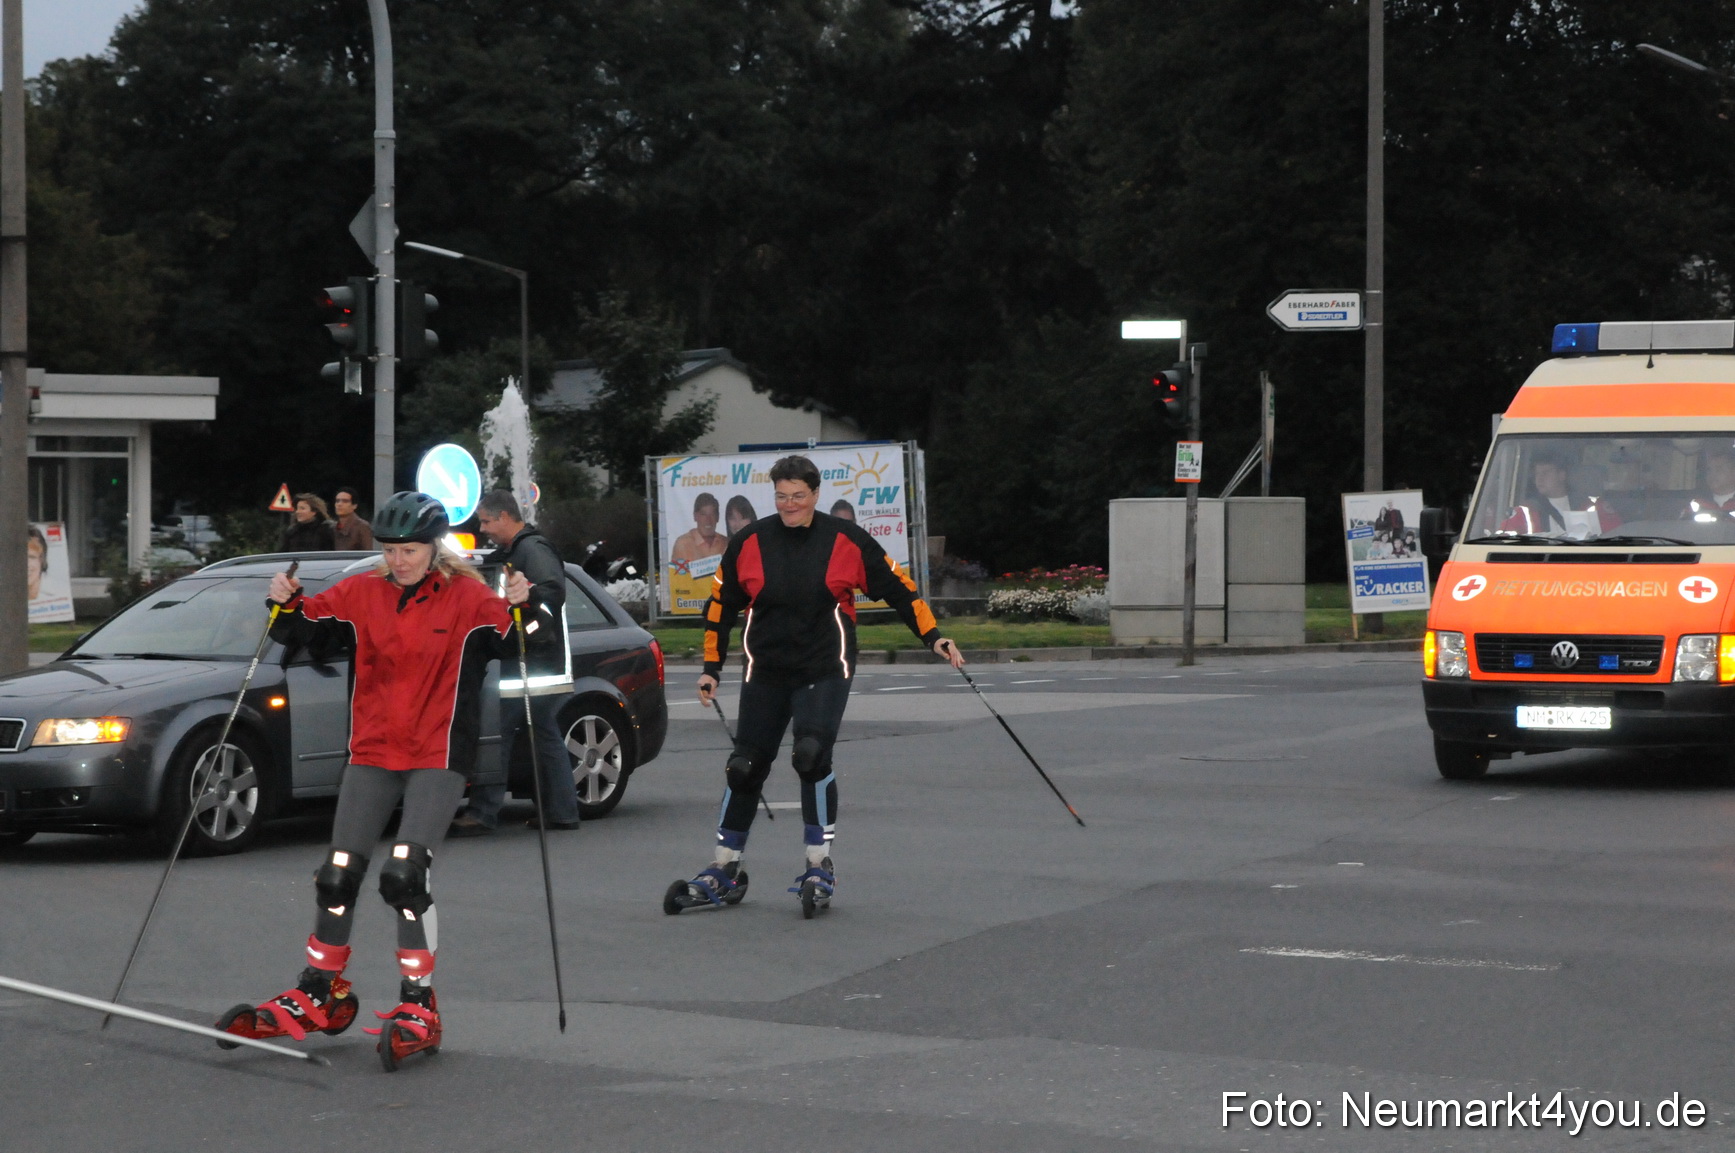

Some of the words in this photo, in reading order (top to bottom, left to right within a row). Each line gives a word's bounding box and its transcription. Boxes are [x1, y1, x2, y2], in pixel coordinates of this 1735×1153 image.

[671, 465, 727, 487] Frischer
[858, 485, 900, 506] FW
[875, 507, 901, 515] WÄHLER
[896, 521, 904, 535] 4
[1356, 579, 1423, 595] FÜRACKER
[1492, 580, 1667, 597] RETTUNGSWAGEN
[1526, 711, 1546, 725] NM
[1556, 711, 1575, 725] RK
[1580, 711, 1607, 725] 425
